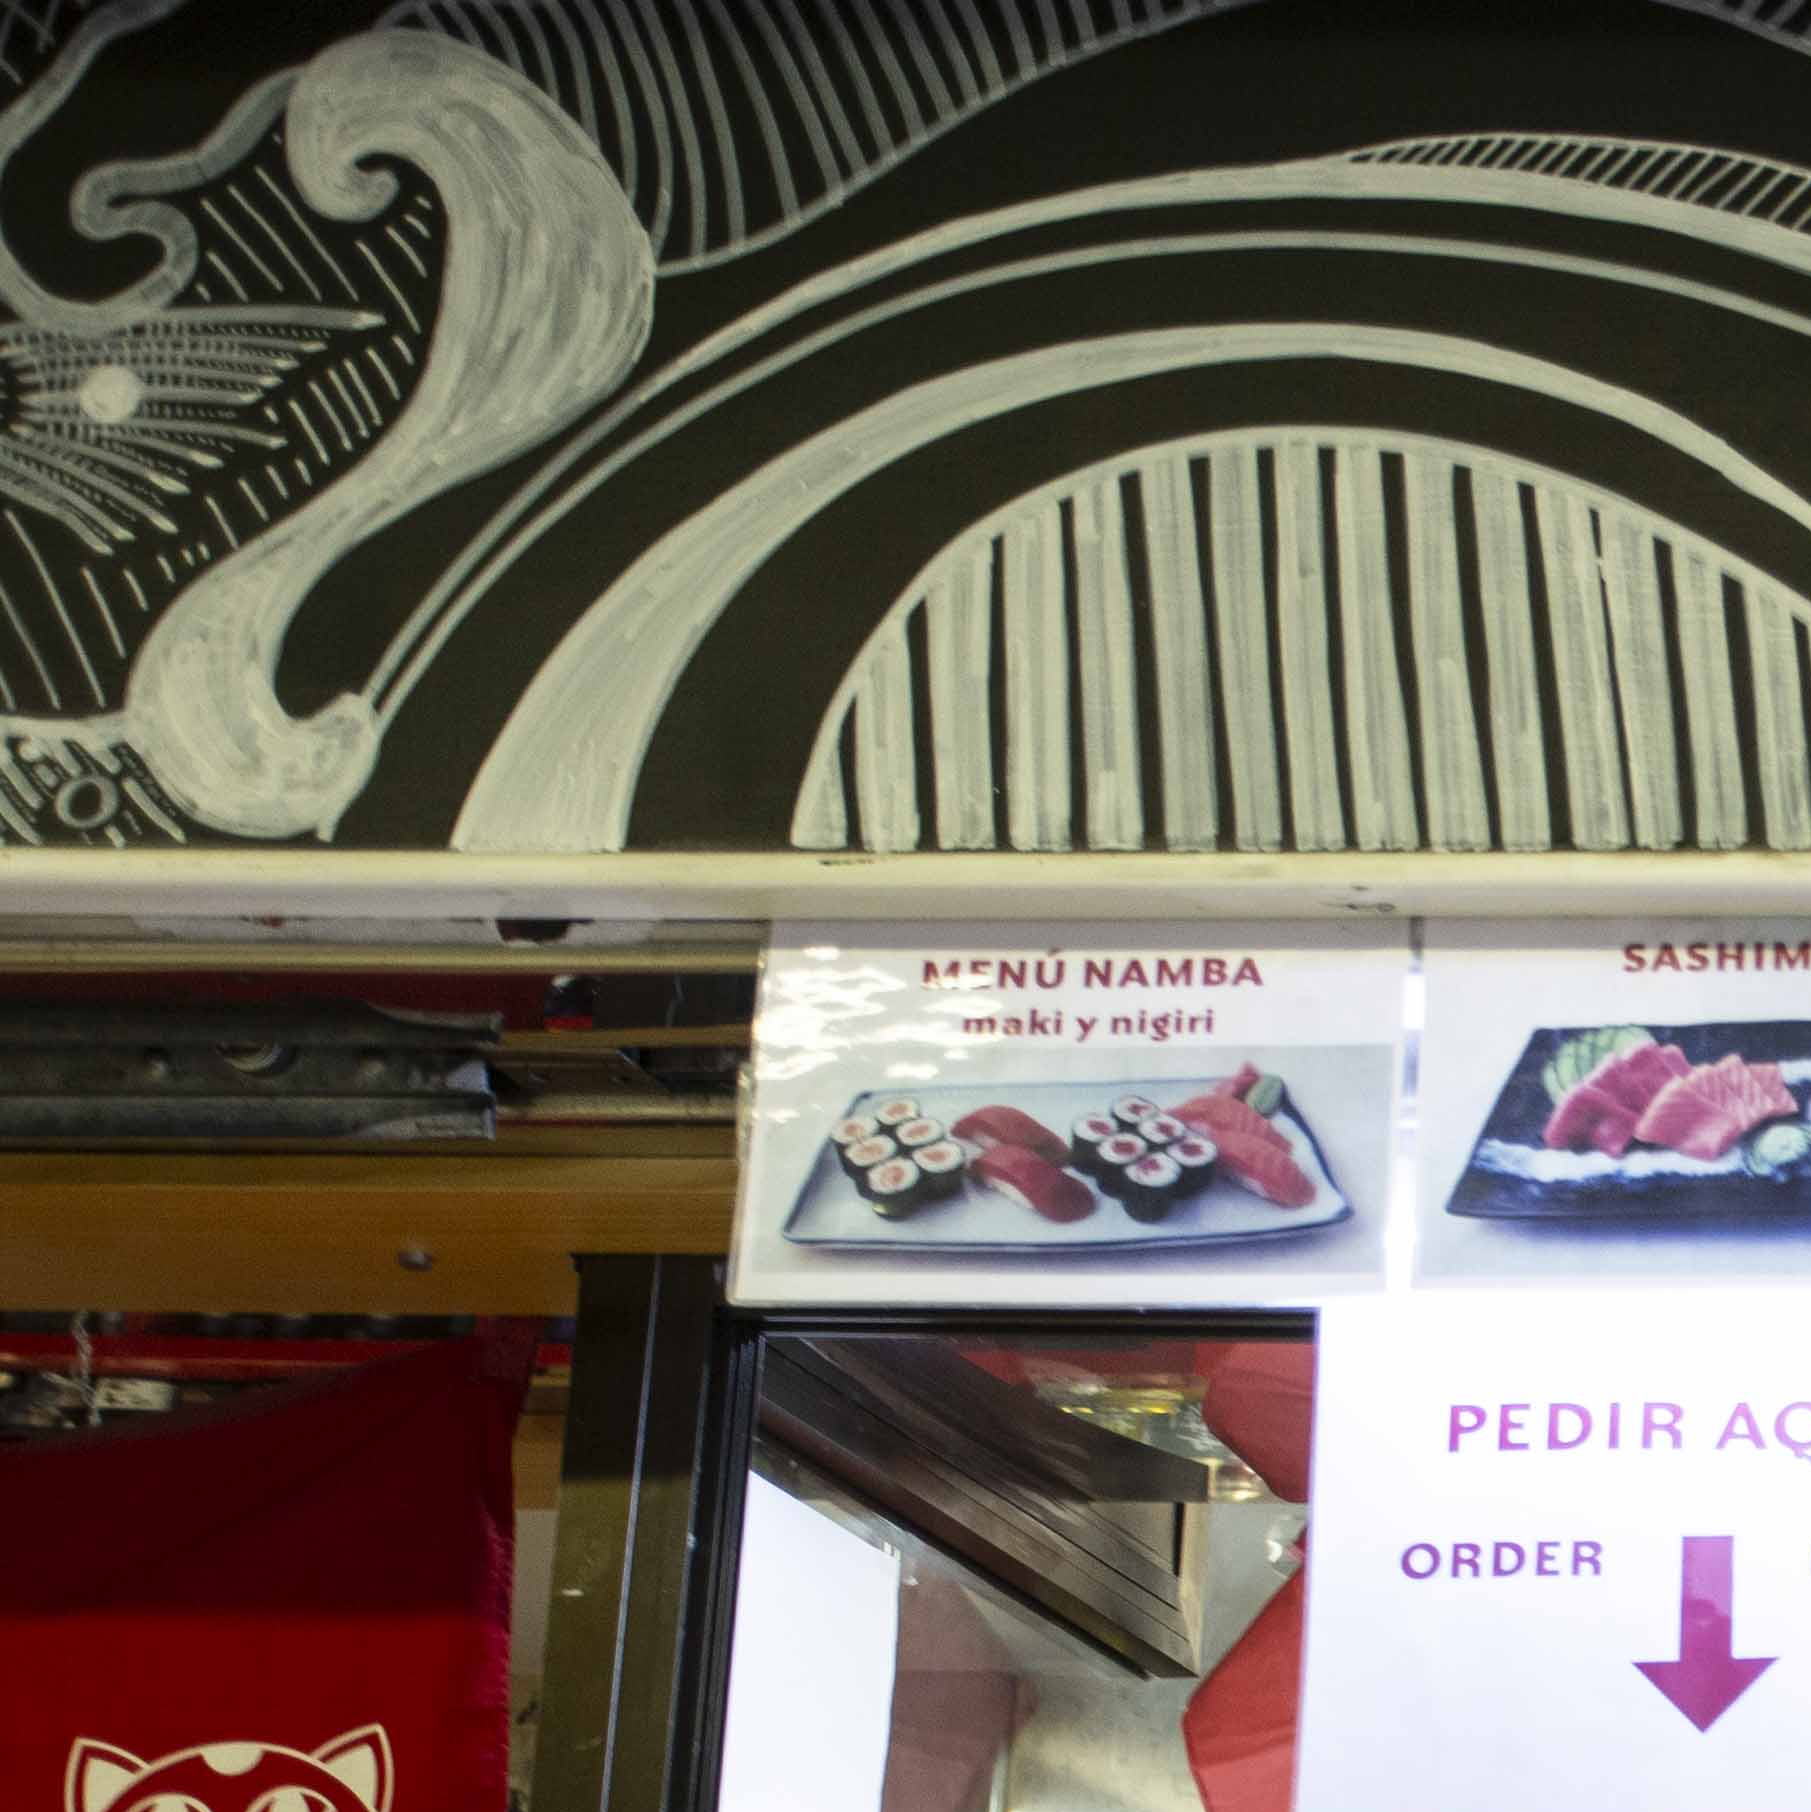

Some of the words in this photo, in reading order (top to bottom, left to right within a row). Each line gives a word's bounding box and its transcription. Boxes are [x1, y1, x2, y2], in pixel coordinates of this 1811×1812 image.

[920, 950, 1067, 992] MENÚ
[1083, 957, 1264, 989] NAMBA
[960, 1008, 1062, 1036] maki
[1075, 1013, 1098, 1041] y
[1109, 1008, 1215, 1041] nigiri
[1448, 1401, 1684, 1453] PEDIR
[1401, 1541, 1603, 1580] ORDER
